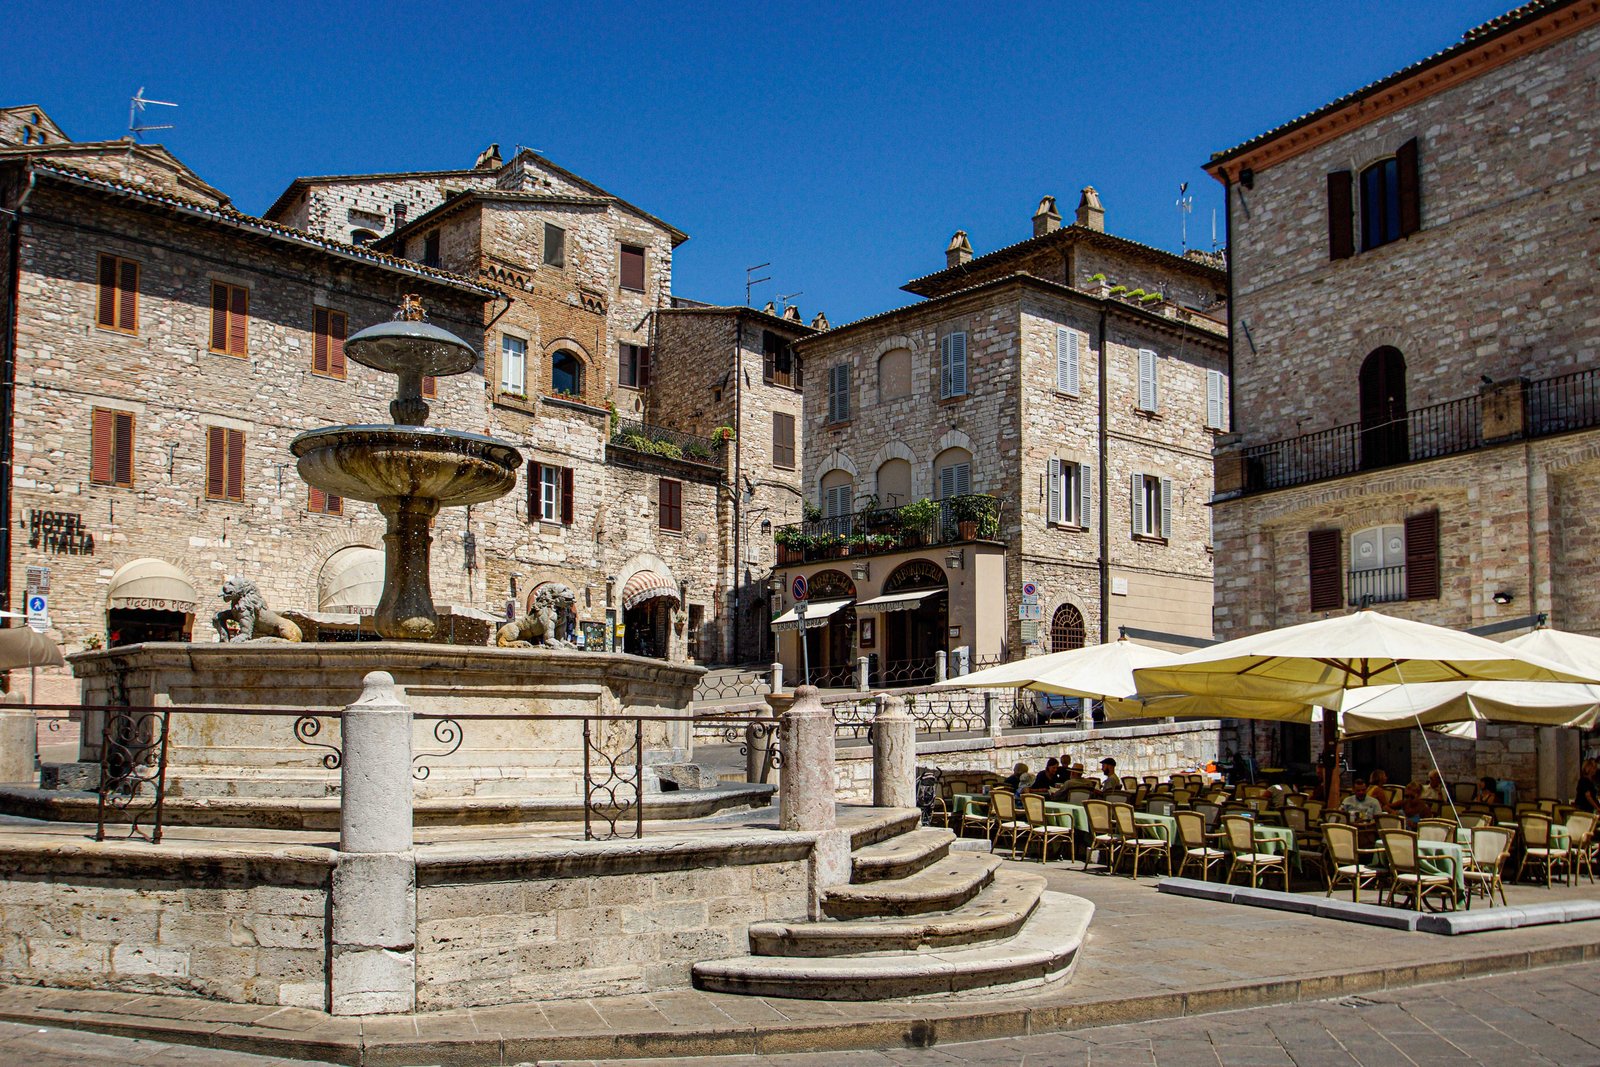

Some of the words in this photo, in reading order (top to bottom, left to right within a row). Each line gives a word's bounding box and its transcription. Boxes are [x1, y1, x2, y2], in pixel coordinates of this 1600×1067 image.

[31, 510, 86, 533] HOTEL
[43, 532, 95, 556] ITALIA
[126, 598, 165, 608] PICCINO
[347, 605, 375, 614] TRATT
